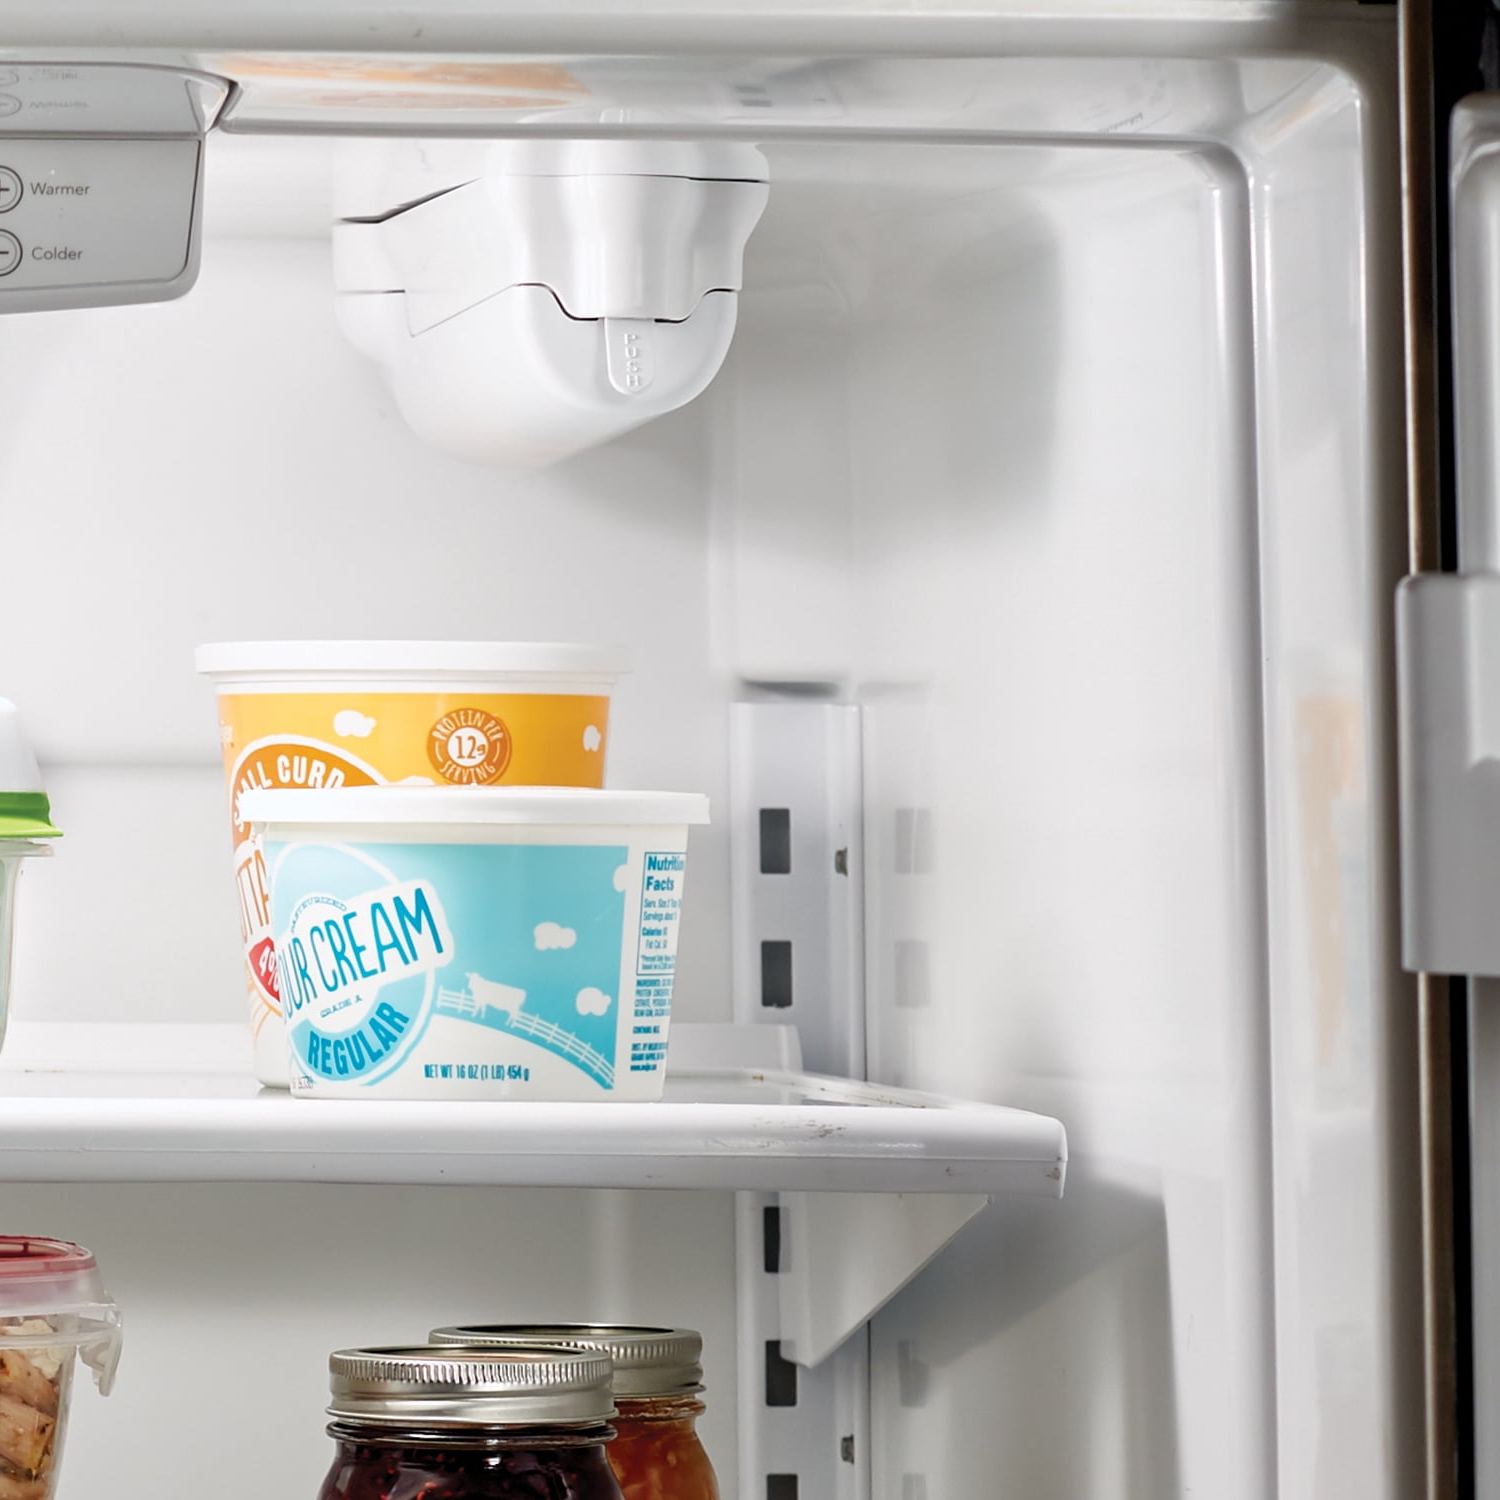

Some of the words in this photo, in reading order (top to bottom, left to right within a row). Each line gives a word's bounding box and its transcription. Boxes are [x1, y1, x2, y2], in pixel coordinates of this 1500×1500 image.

[30, 182, 90, 195] Warmer
[31, 246, 83, 261] Colder
[431, 710, 486, 740] PROTEIN
[483, 719, 504, 742] PER
[276, 755, 345, 789] CURD
[439, 760, 496, 783] SERVING
[645, 876, 675, 891] Facts
[278, 937, 318, 1022] OUR
[310, 887, 444, 992] CREAM
[320, 998, 353, 1018] GRADE
[355, 994, 363, 1003] A
[307, 1002, 410, 1076] REGULAR
[423, 1064, 438, 1079] NET
[440, 1064, 453, 1079] WT
[456, 1064, 466, 1079] 16
[468, 1064, 478, 1079] OZ
[507, 1065, 522, 1080] 454
